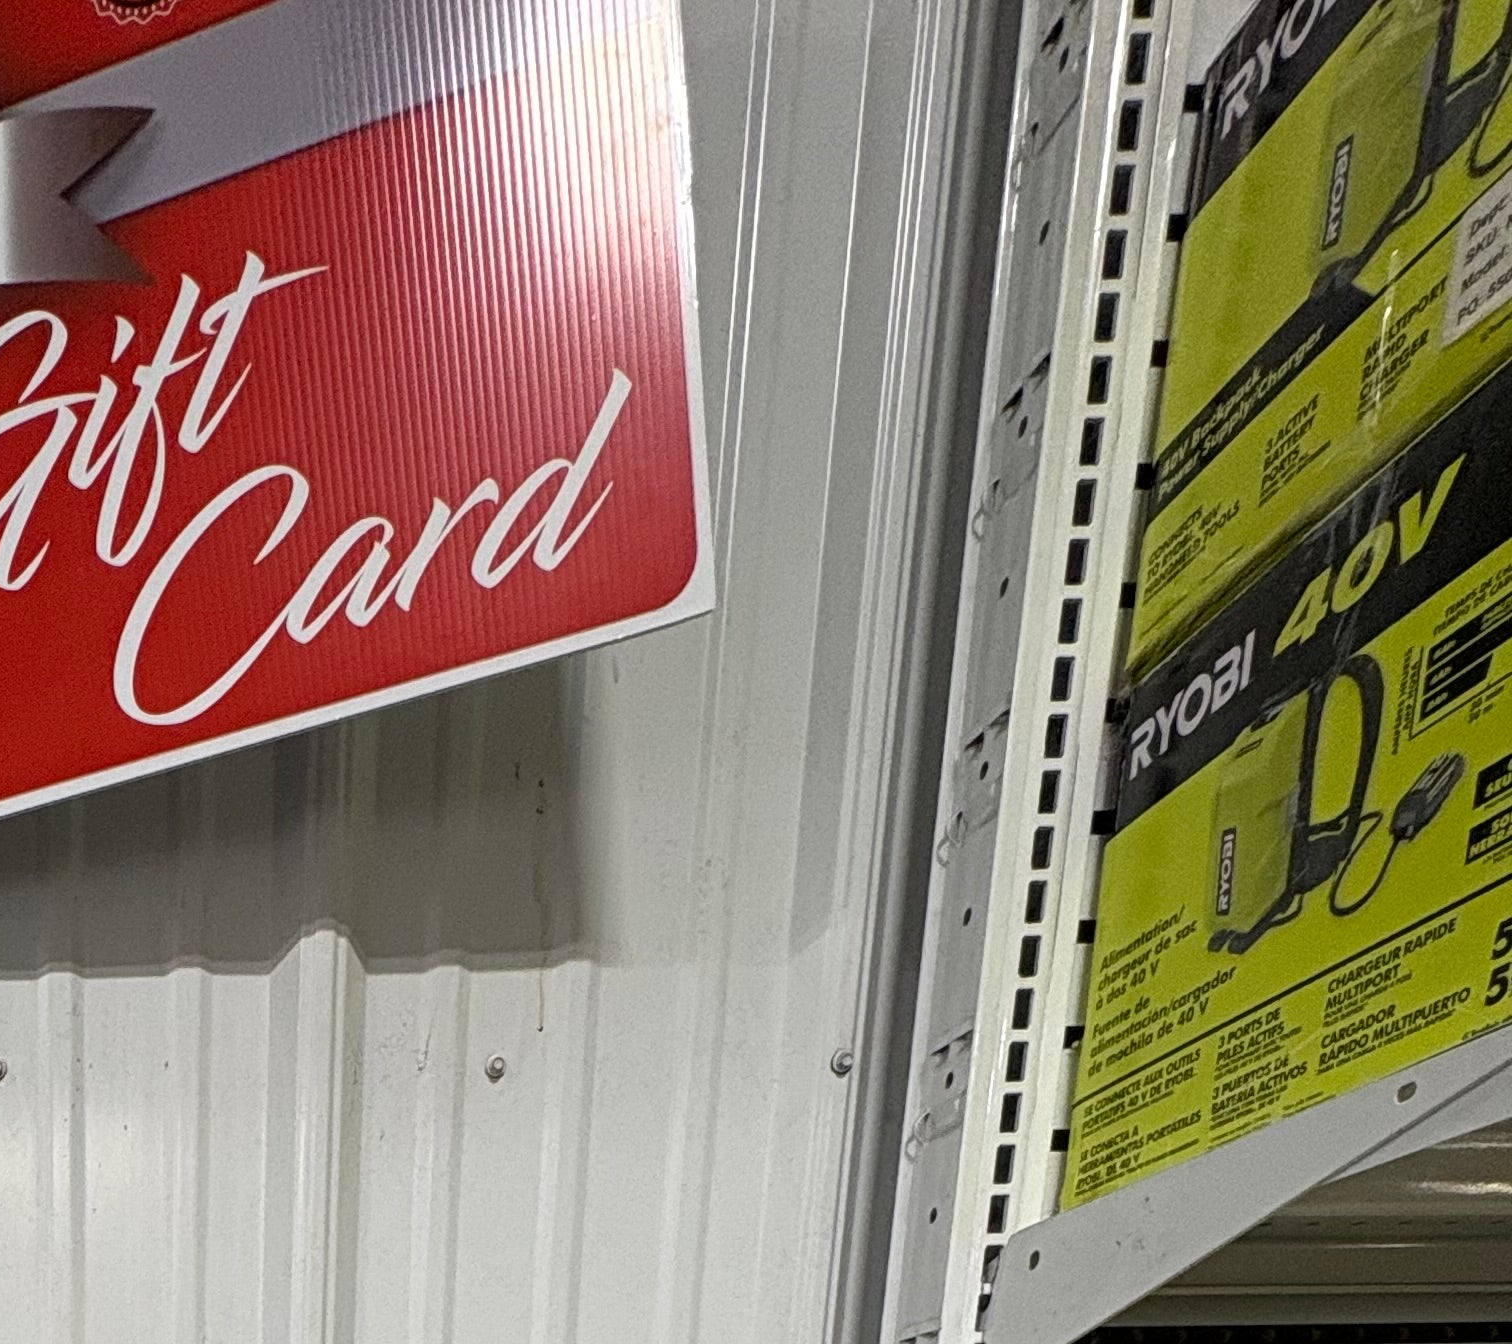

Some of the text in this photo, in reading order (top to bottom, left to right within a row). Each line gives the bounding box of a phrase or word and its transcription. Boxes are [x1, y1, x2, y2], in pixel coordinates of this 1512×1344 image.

[1220, 0, 1336, 141] RYO
[1192, 366, 1262, 446] Backpack
[113, 369, 633, 727] Card
[1129, 630, 1257, 780] RYOBI
[1273, 453, 1468, 656] 40V
[1217, 833, 1235, 913] RYOBI
[1097, 948, 1153, 993] chargeur
[1155, 932, 1172, 954] de
[1100, 904, 1186, 974] Alimentation/
[1327, 917, 1458, 995] CHARGEUR RAPIDE
[1106, 982, 1127, 1006] dos
[1131, 967, 1148, 990] 40
[1149, 957, 1162, 979] V
[1324, 962, 1402, 1013] MULTIPORT
[1088, 997, 1211, 1078] de mochila de 40 V
[1092, 995, 1152, 1041] Fuente de
[1228, 1016, 1264, 1046] PORTS
[1265, 1006, 1282, 1026] DE
[1246, 1020, 1286, 1051] ACTIFS
[1320, 1004, 1397, 1050] CARGADOR
[1370, 986, 1472, 1045] MULTIPUERTO
[1142, 1066, 1165, 1092] AUX
[1165, 1047, 1202, 1083] OUTILS
[1221, 1061, 1272, 1097] PUERTOS
[1274, 1053, 1290, 1072] DE
[1256, 1061, 1308, 1095] ACTIVOS
